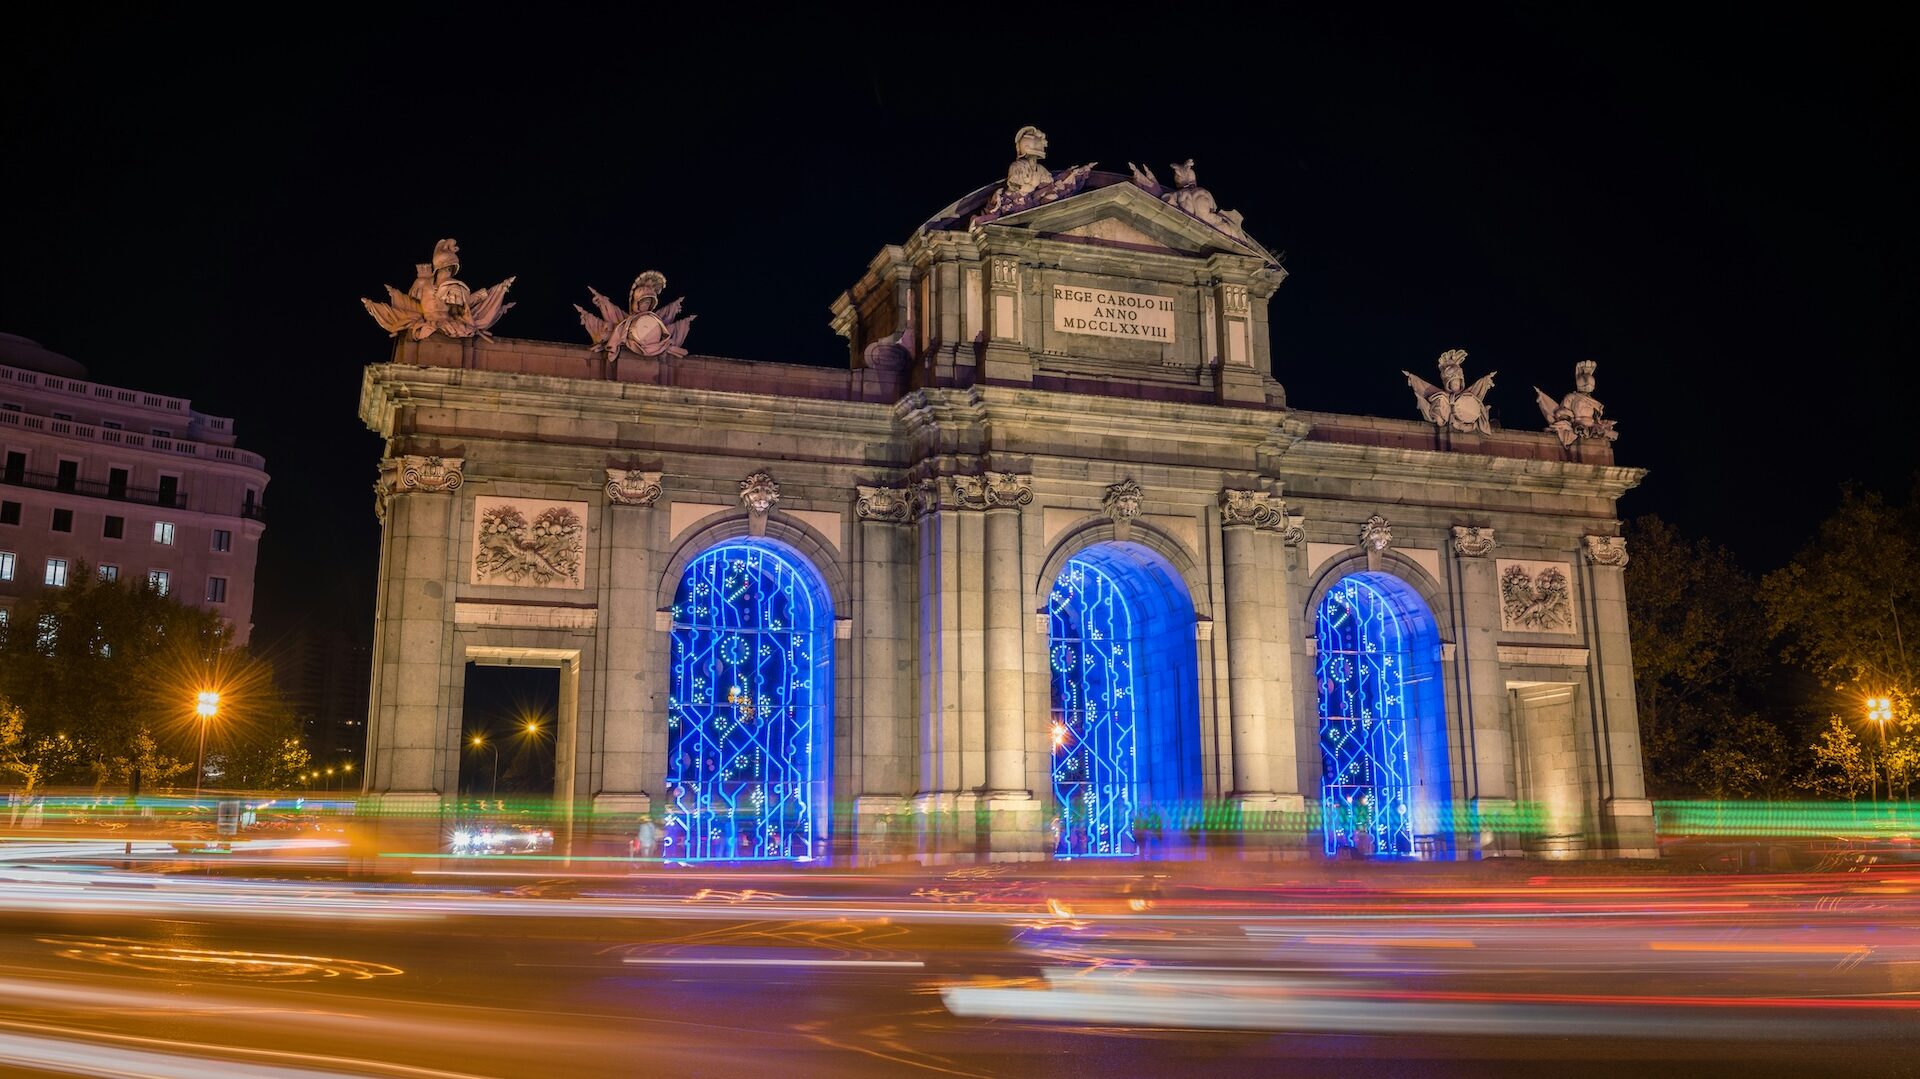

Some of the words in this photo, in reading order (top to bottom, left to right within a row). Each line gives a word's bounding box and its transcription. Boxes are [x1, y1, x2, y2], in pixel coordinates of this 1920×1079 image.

[1054, 288, 1093, 303] REGE
[1097, 293, 1155, 309] CAROLO
[1159, 300, 1174, 312] III
[1094, 307, 1138, 321] ANNO
[1063, 317, 1168, 338] MDCCLXXVIII
